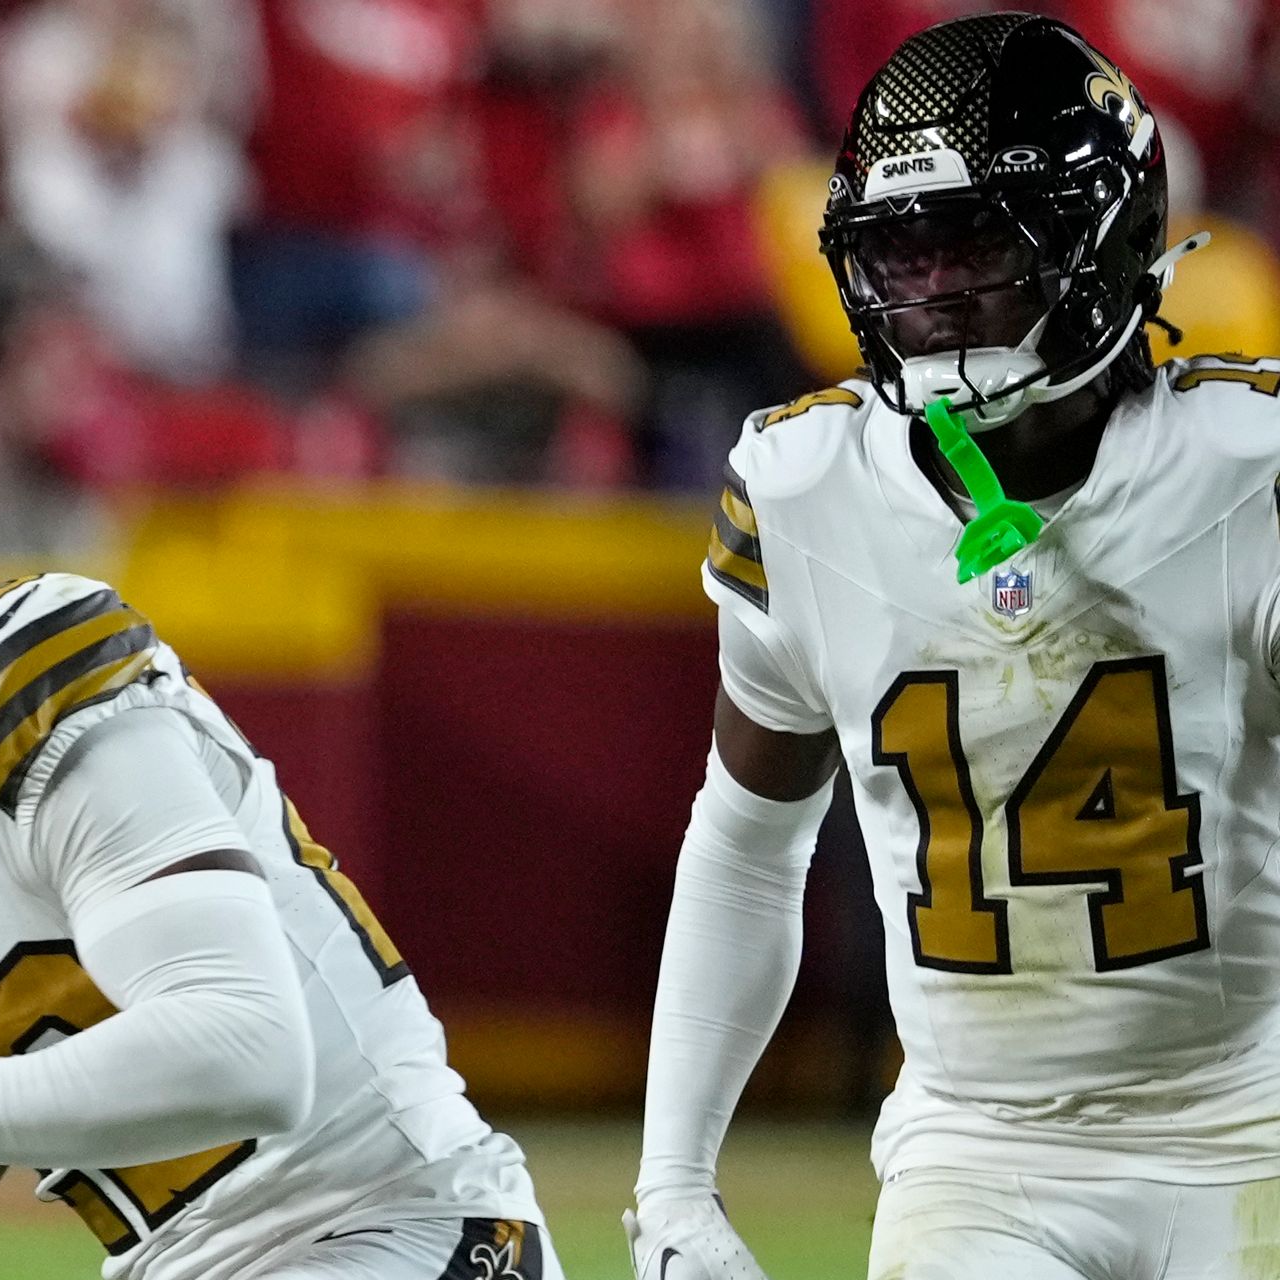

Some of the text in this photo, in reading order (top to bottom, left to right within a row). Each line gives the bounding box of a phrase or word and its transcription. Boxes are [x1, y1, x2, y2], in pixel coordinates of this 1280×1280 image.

[882, 157, 935, 179] SAINTS
[994, 162, 1045, 174] OAKLEY
[998, 589, 1026, 609] NFL
[871, 654, 1211, 975] 14
